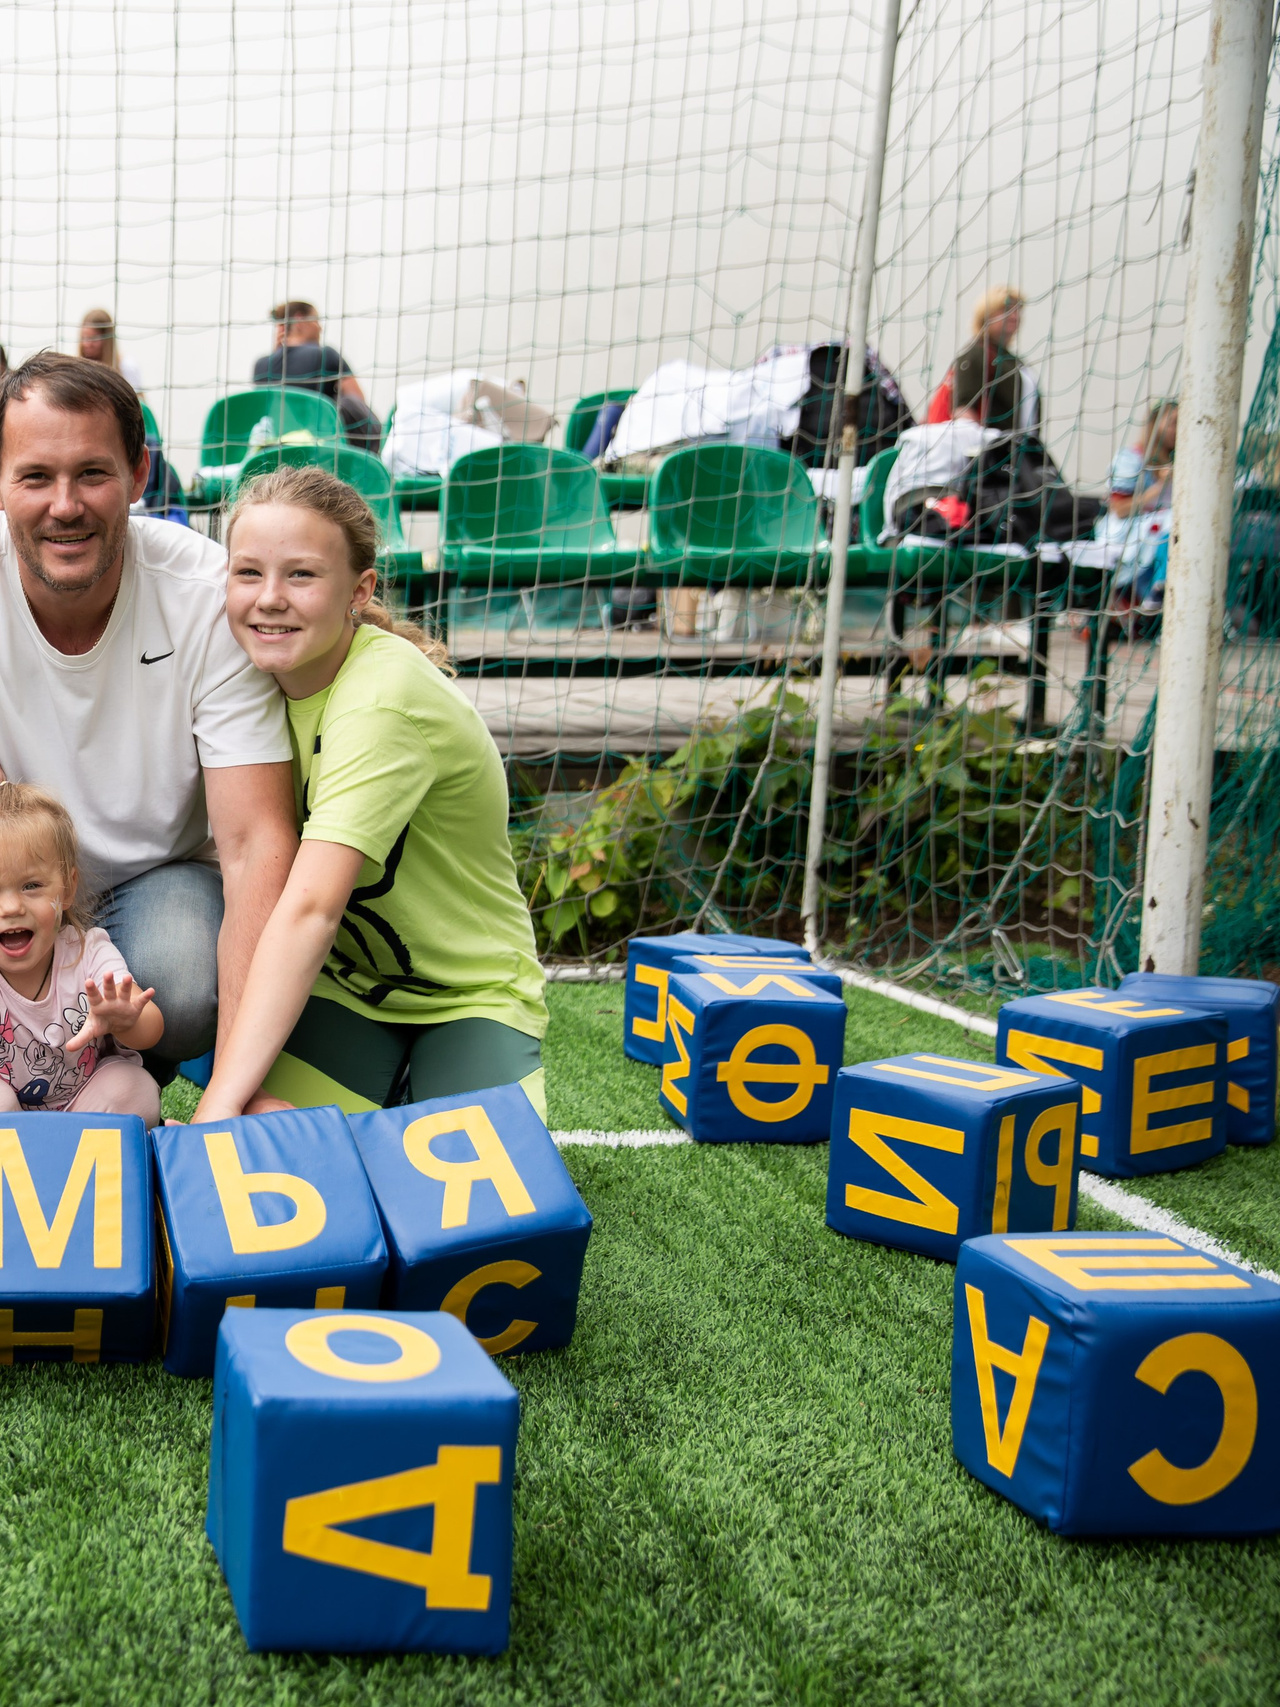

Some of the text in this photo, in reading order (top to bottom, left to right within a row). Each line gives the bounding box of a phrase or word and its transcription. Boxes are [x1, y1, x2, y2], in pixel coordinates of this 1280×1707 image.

[717, 1024, 829, 1123] Ф
[286, 1316, 440, 1381] О
[440, 1260, 542, 1355] С
[965, 1284, 1050, 1478] А
[1128, 1333, 1258, 1505] С
[283, 1445, 501, 1611] Д
